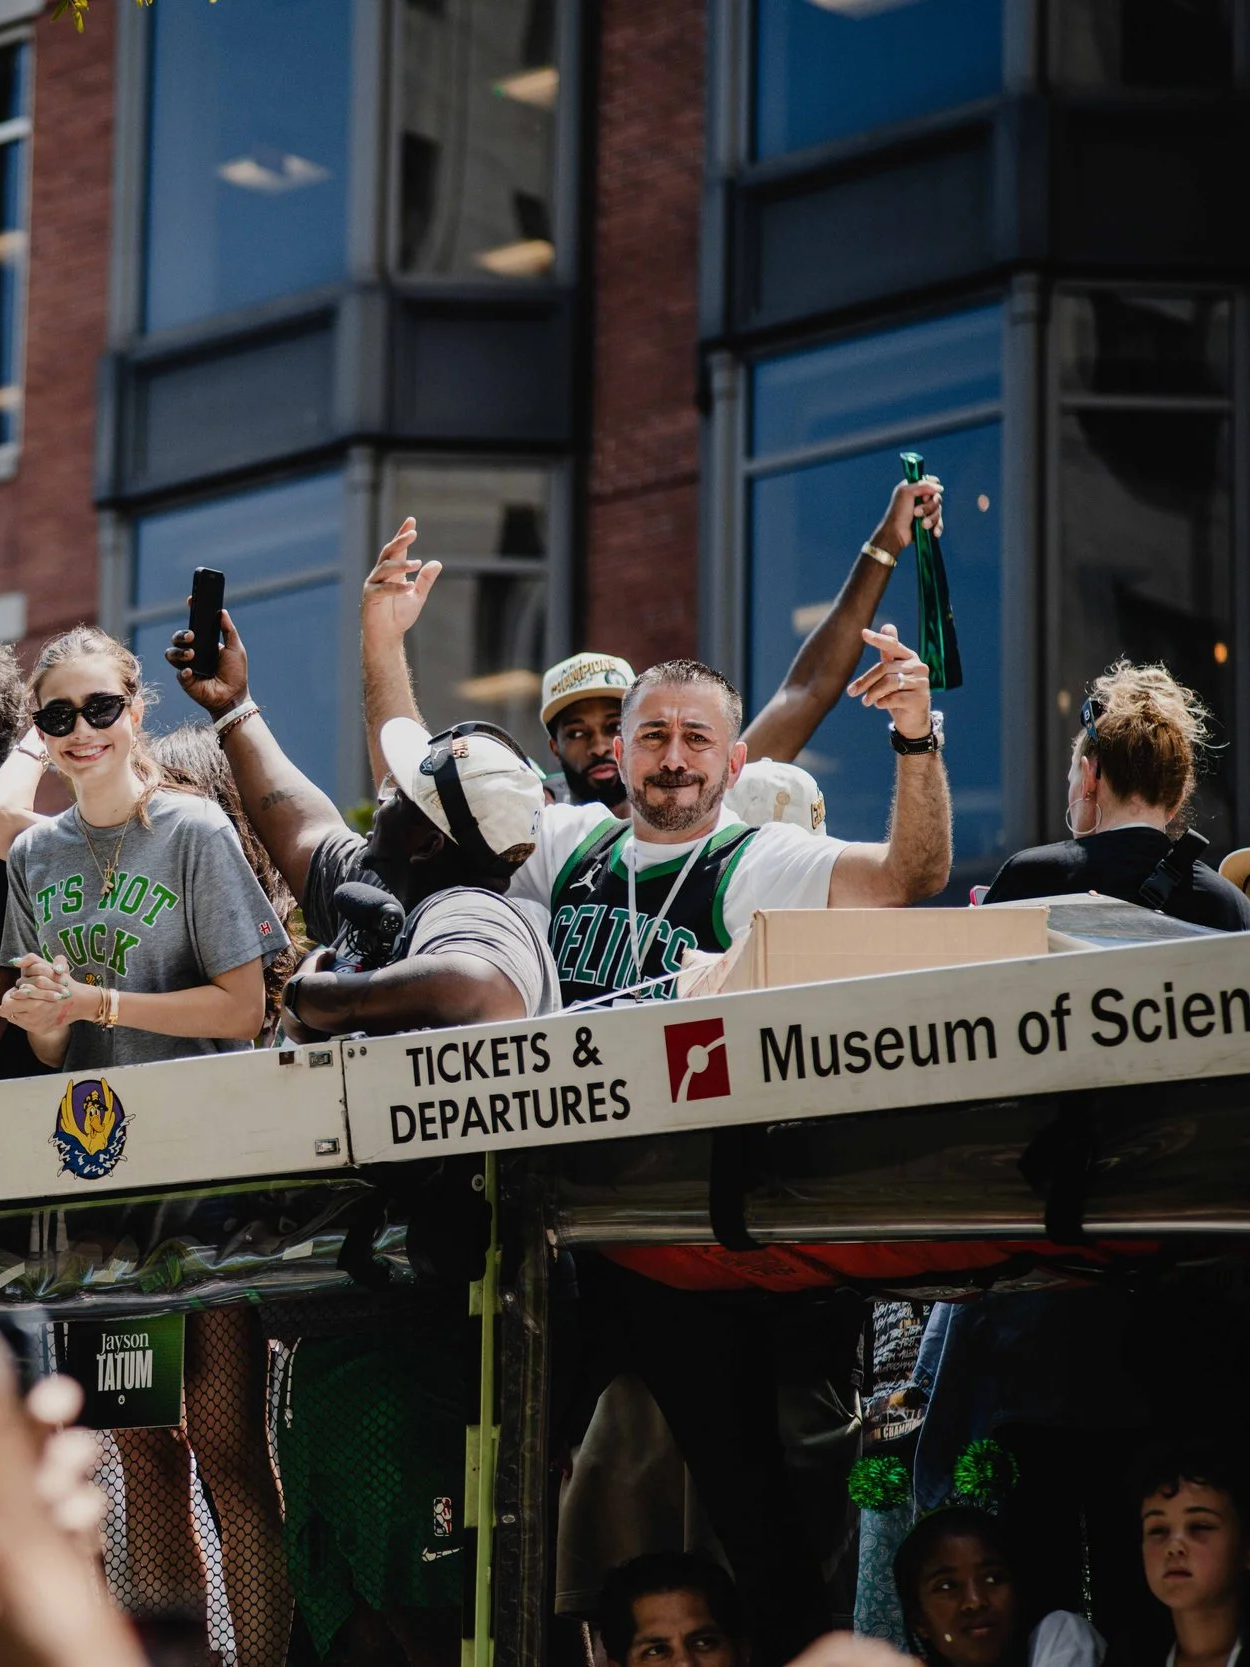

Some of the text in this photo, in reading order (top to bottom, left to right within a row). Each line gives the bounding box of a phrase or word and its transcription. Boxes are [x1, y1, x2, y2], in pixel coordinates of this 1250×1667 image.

[97, 871, 180, 928] NOT
[551, 903, 699, 1000] CELTICS
[405, 1026, 604, 1088] TICKETS &
[759, 981, 1250, 1084] Museum of Scien
[389, 1078, 632, 1146] DEPARTURES
[96, 1349, 153, 1392] TATUM
[100, 1332, 150, 1355] Jayson
